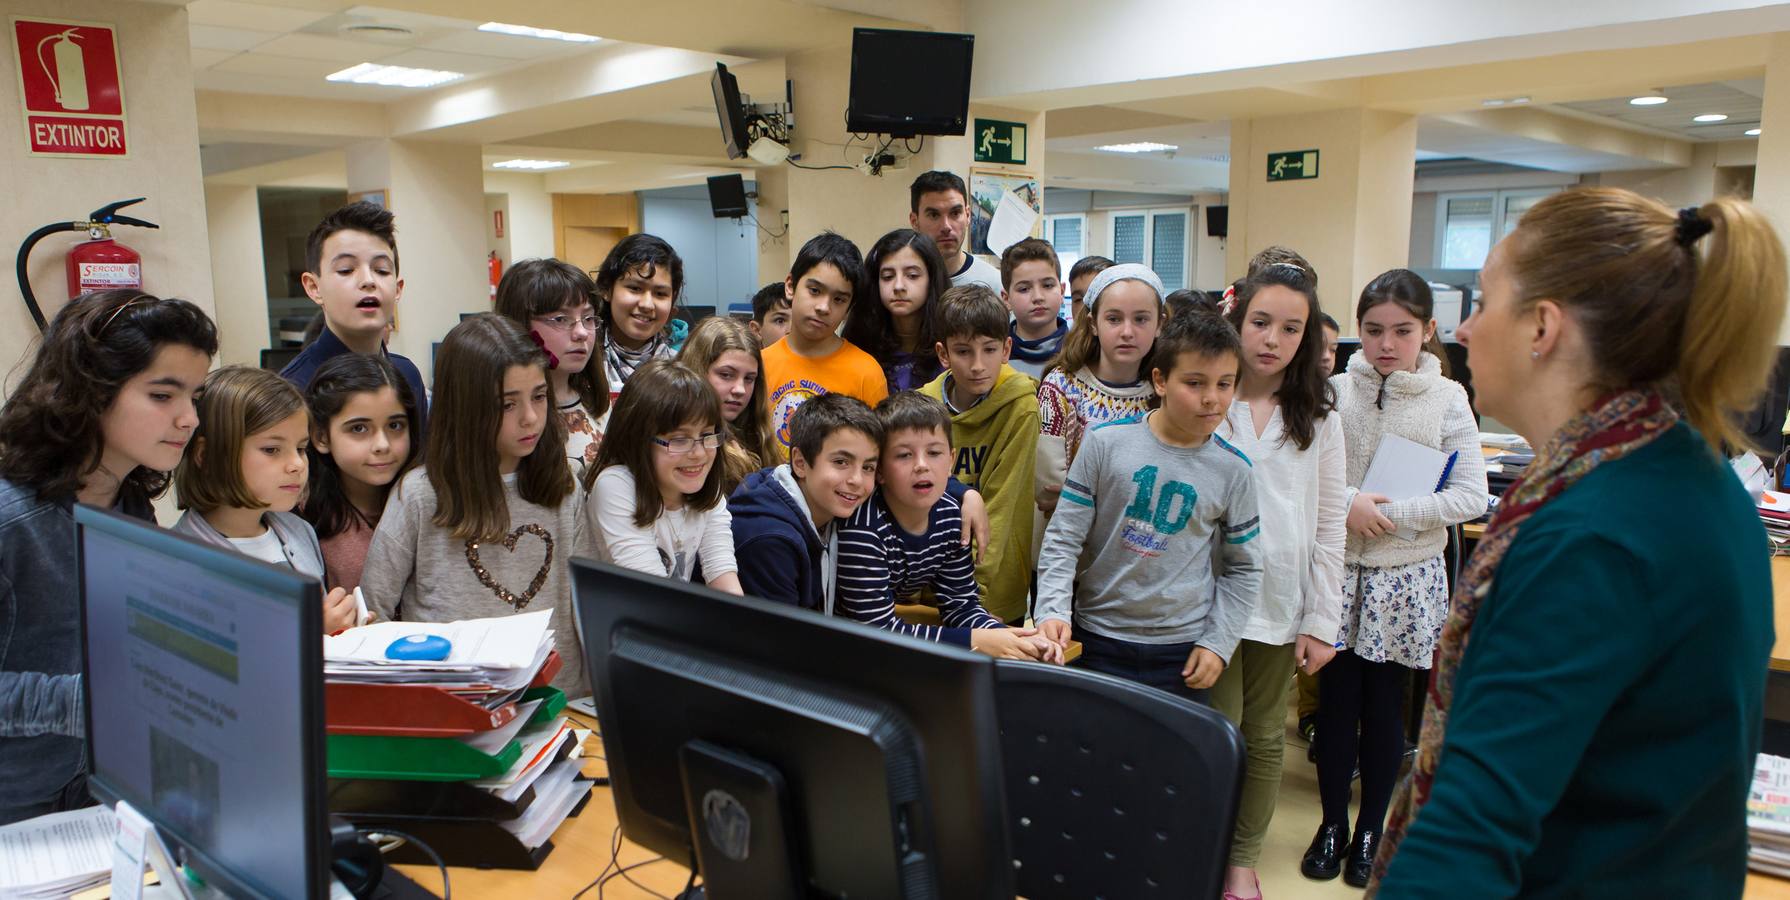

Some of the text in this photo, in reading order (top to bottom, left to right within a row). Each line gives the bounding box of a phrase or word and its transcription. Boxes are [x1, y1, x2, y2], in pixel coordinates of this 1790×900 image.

[34, 123, 122, 149] EXTINTOR
[800, 379, 827, 396] surfin
[953, 444, 988, 475] AY
[1125, 464, 1198, 535] 10
[1120, 525, 1168, 552] Football
